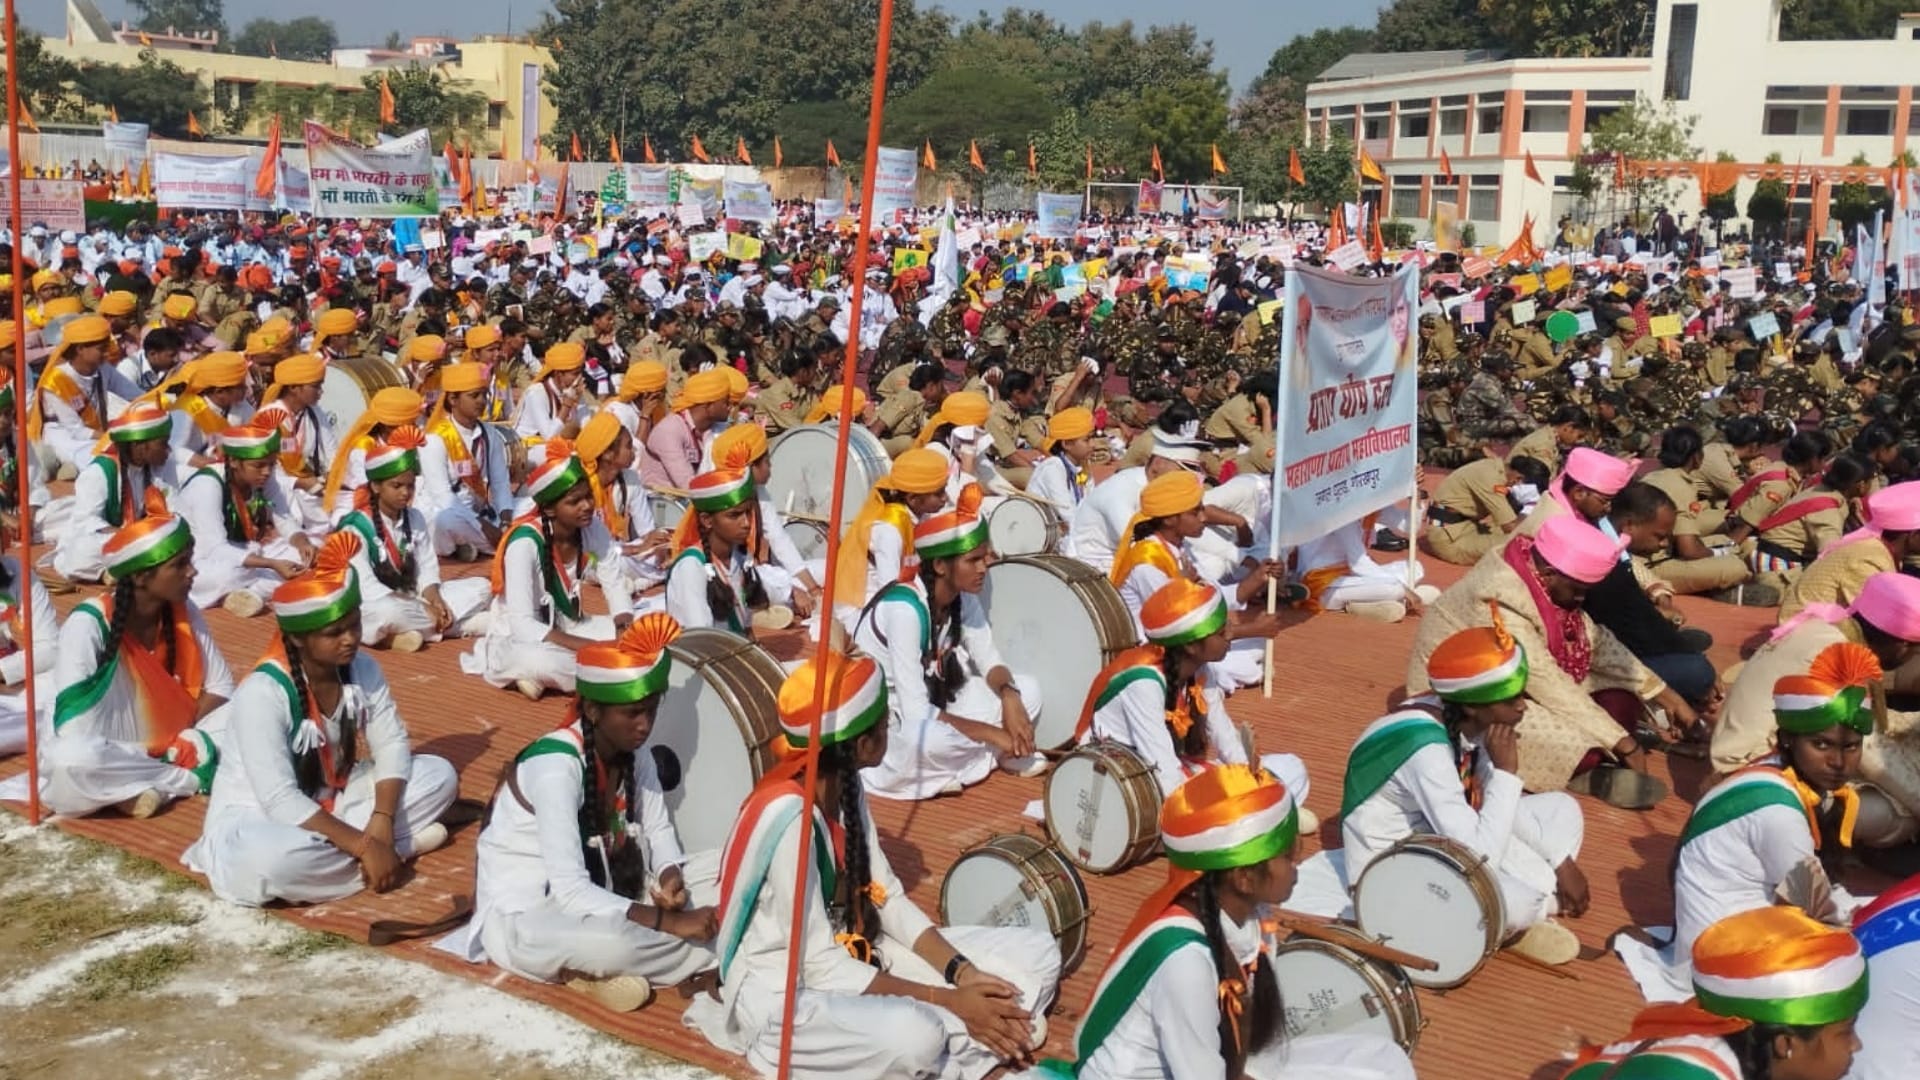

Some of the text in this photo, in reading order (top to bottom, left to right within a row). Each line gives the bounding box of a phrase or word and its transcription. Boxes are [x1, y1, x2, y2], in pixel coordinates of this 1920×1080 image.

[311, 168, 330, 181] हम
[352, 170, 389, 185] भारती
[395, 172, 407, 186] के
[381, 190, 393, 203] के
[1285, 454, 1326, 490] महाराणा
